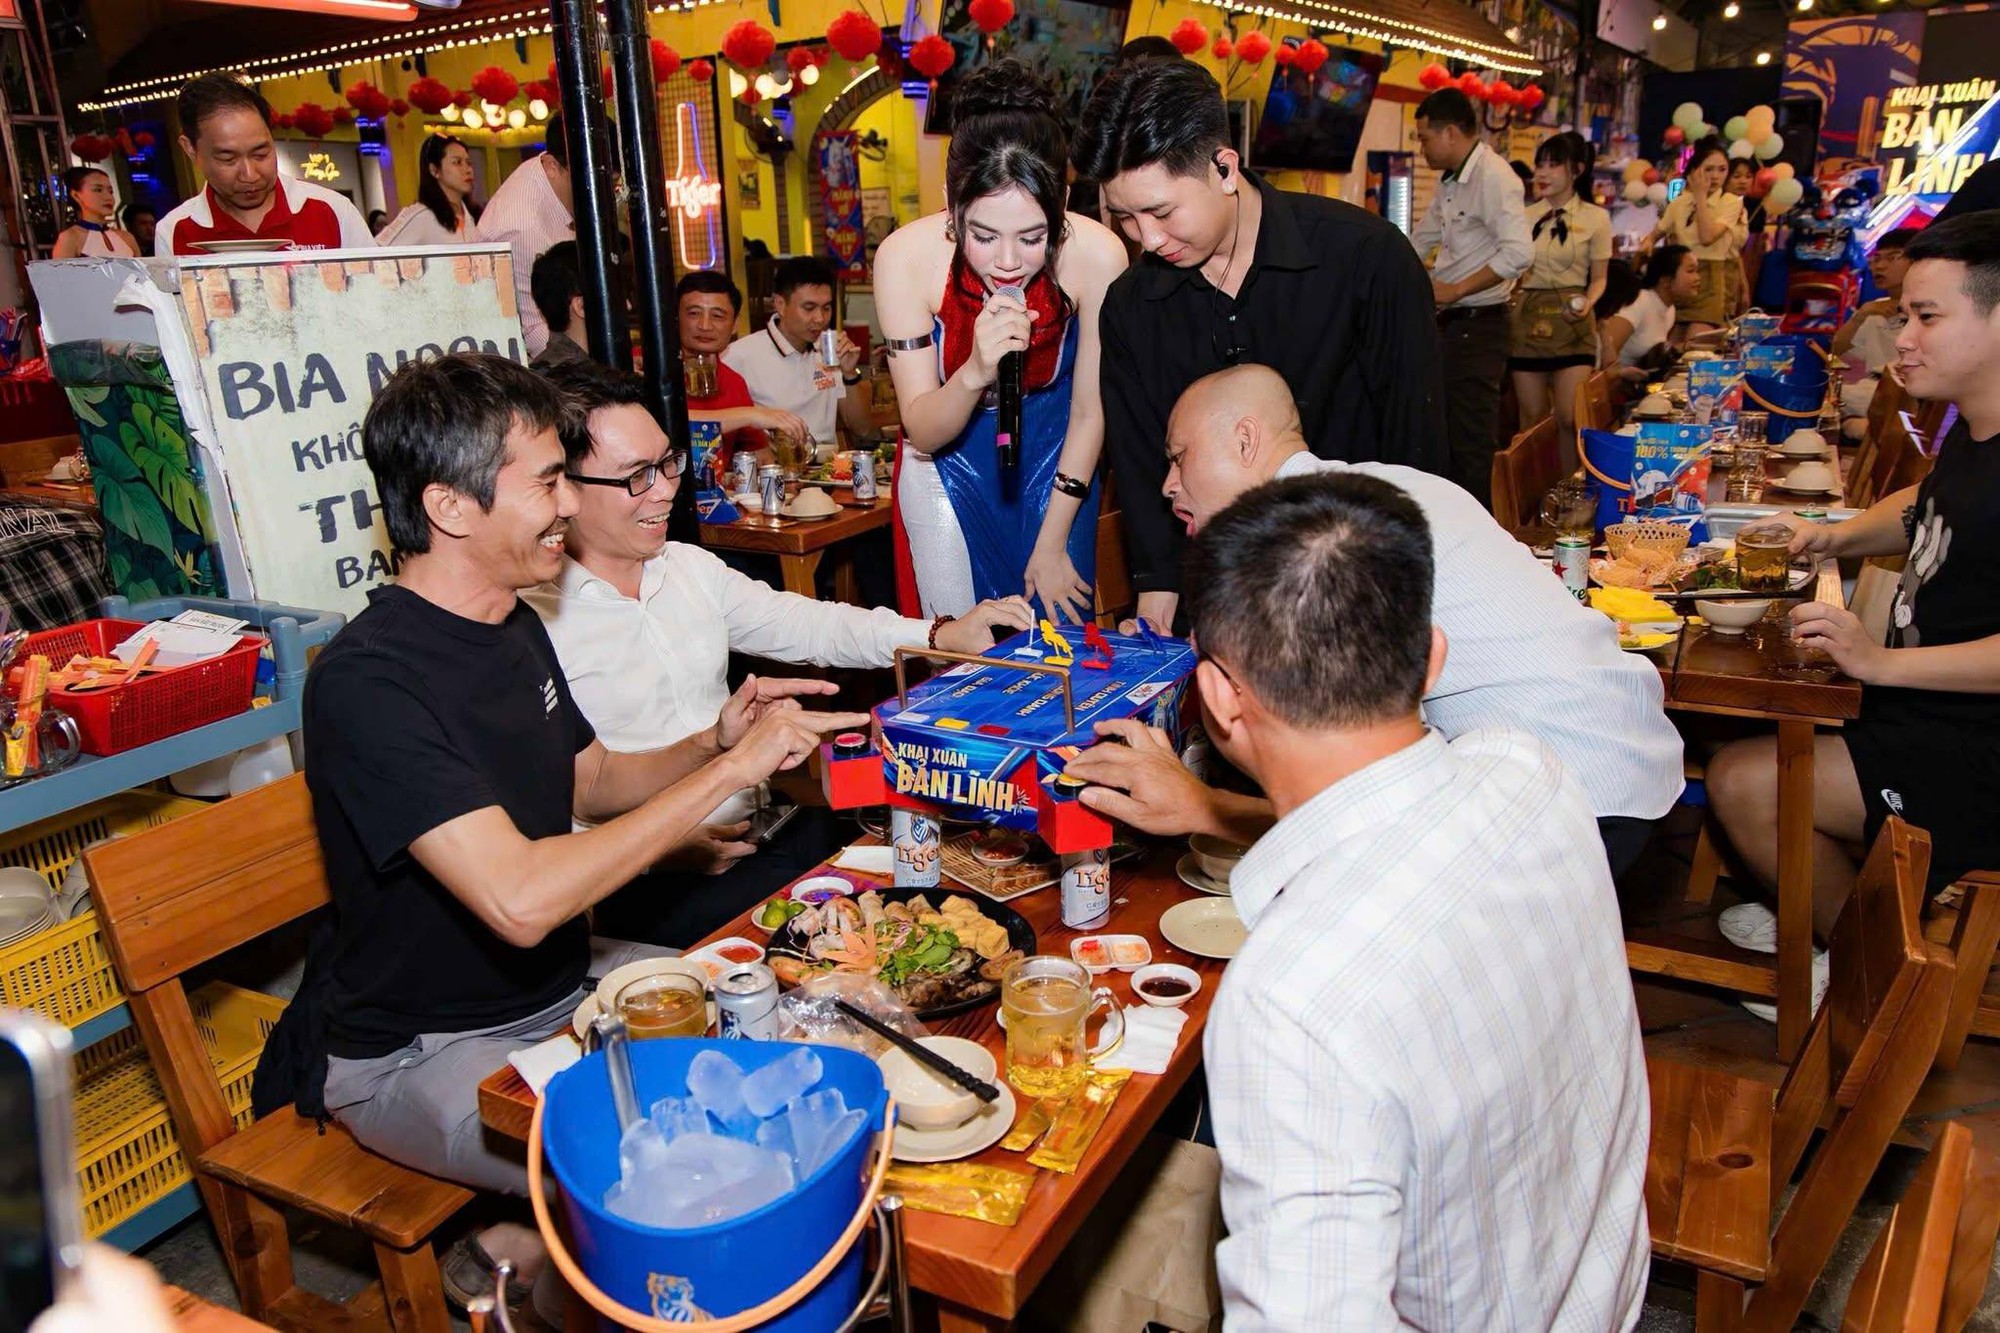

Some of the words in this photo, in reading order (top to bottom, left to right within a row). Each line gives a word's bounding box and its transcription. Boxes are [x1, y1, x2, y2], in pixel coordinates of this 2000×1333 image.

[1940, 77, 1996, 103] XUÂN
[665, 175, 721, 219] Tiger
[218, 352, 347, 420] BIA
[1635, 444, 1668, 459] 100%
[931, 746, 968, 769] XUÂN
[896, 757, 949, 800] BẢN
[951, 769, 1015, 812] LĨNH
[1889, 792, 1903, 811] NIKE
[896, 843, 940, 873] Tige
[1073, 865, 1110, 895] Tig
